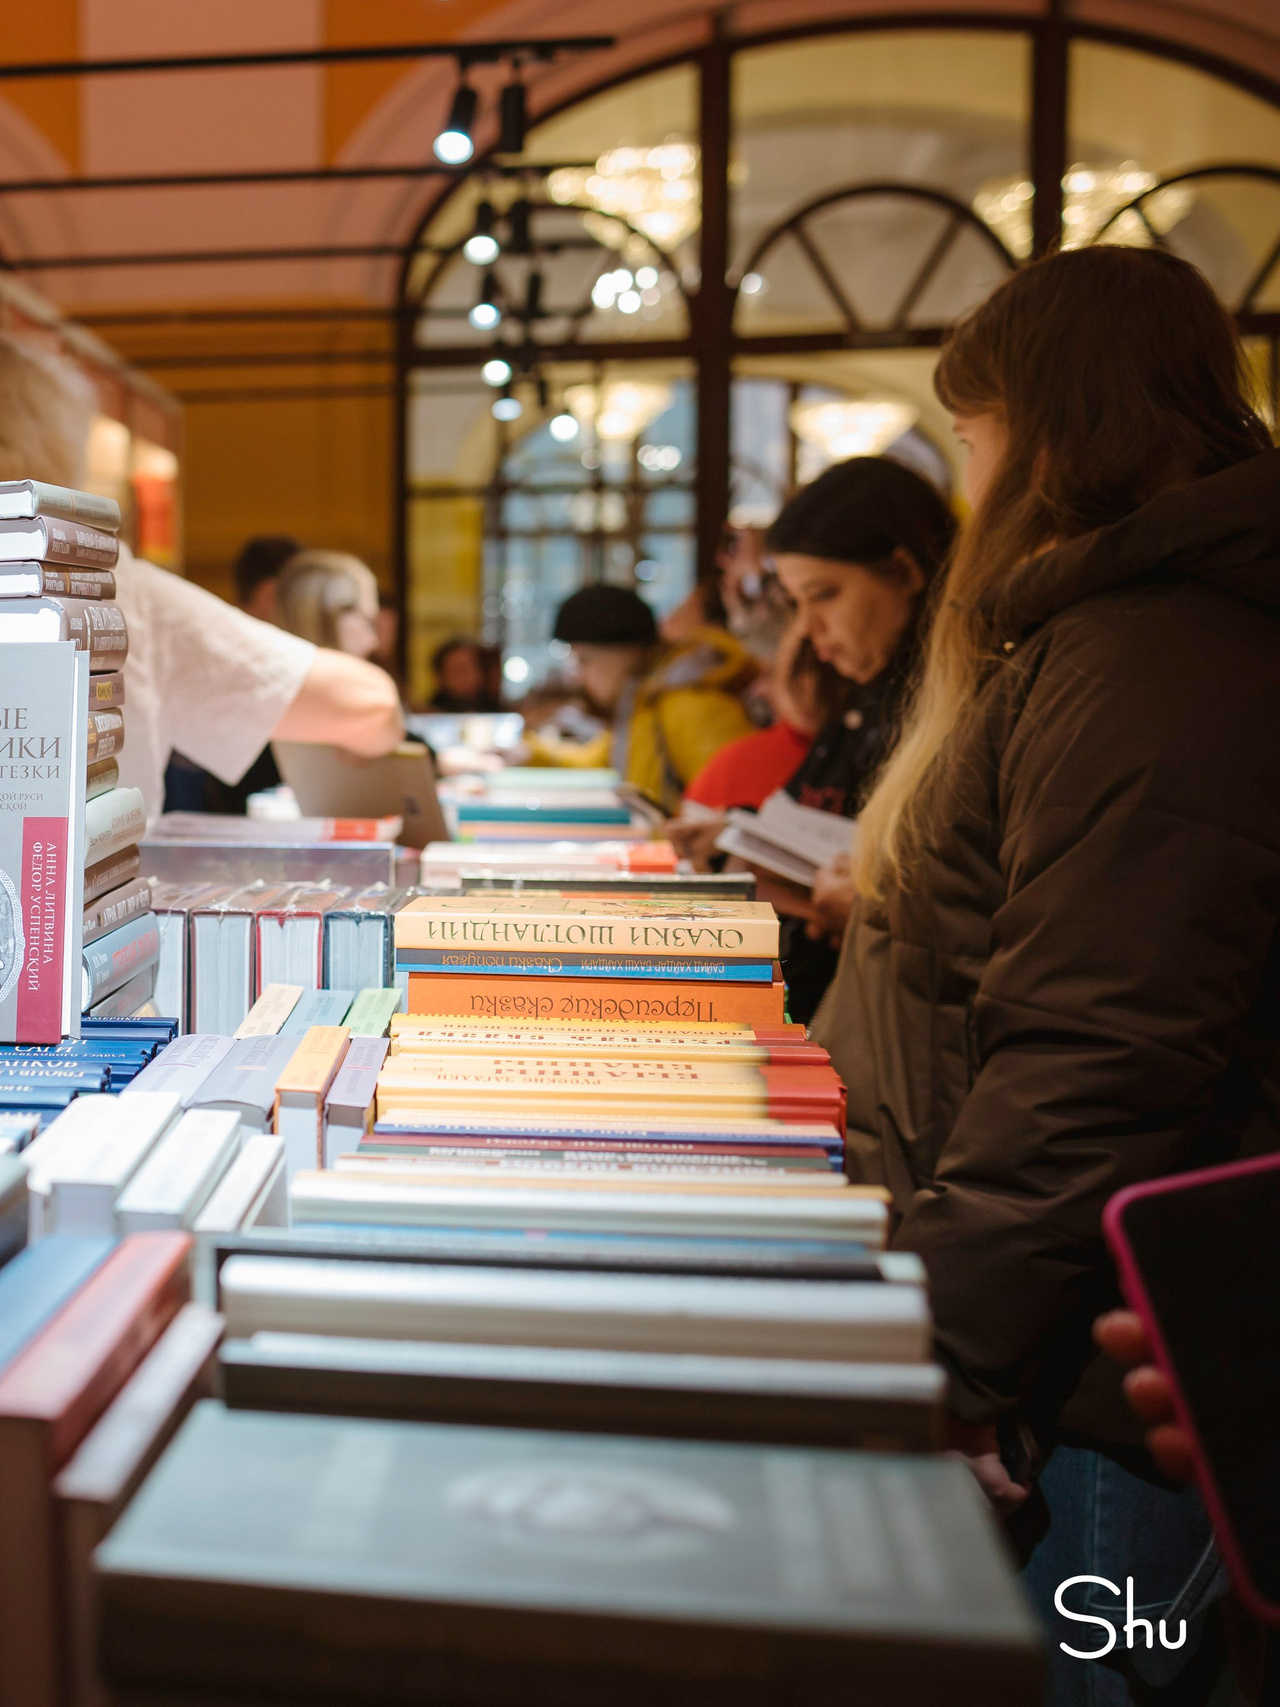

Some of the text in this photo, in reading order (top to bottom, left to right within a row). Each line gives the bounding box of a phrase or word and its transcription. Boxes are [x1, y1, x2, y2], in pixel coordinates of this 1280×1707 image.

[19, 792, 44, 801] РУСИ
[43, 842, 57, 964] АННА ЛИТВИНА
[26, 841, 43, 991] ФЕДОР УСПЕНСКИЙ
[426, 921, 744, 949] СКАЗКИ ШОТЛАНДИИ
[441, 953, 563, 973] Сказки попугая
[581, 958, 725, 973] САЙИД ХАЙДАР БАХШ ХАЙДАРИ
[470, 994, 553, 1018] сказки
[558, 996, 718, 1024] Персидские
[491, 1059, 695, 1071] БЫЛИНЫ
[493, 1068, 699, 1080] БЫЛИНЫ
